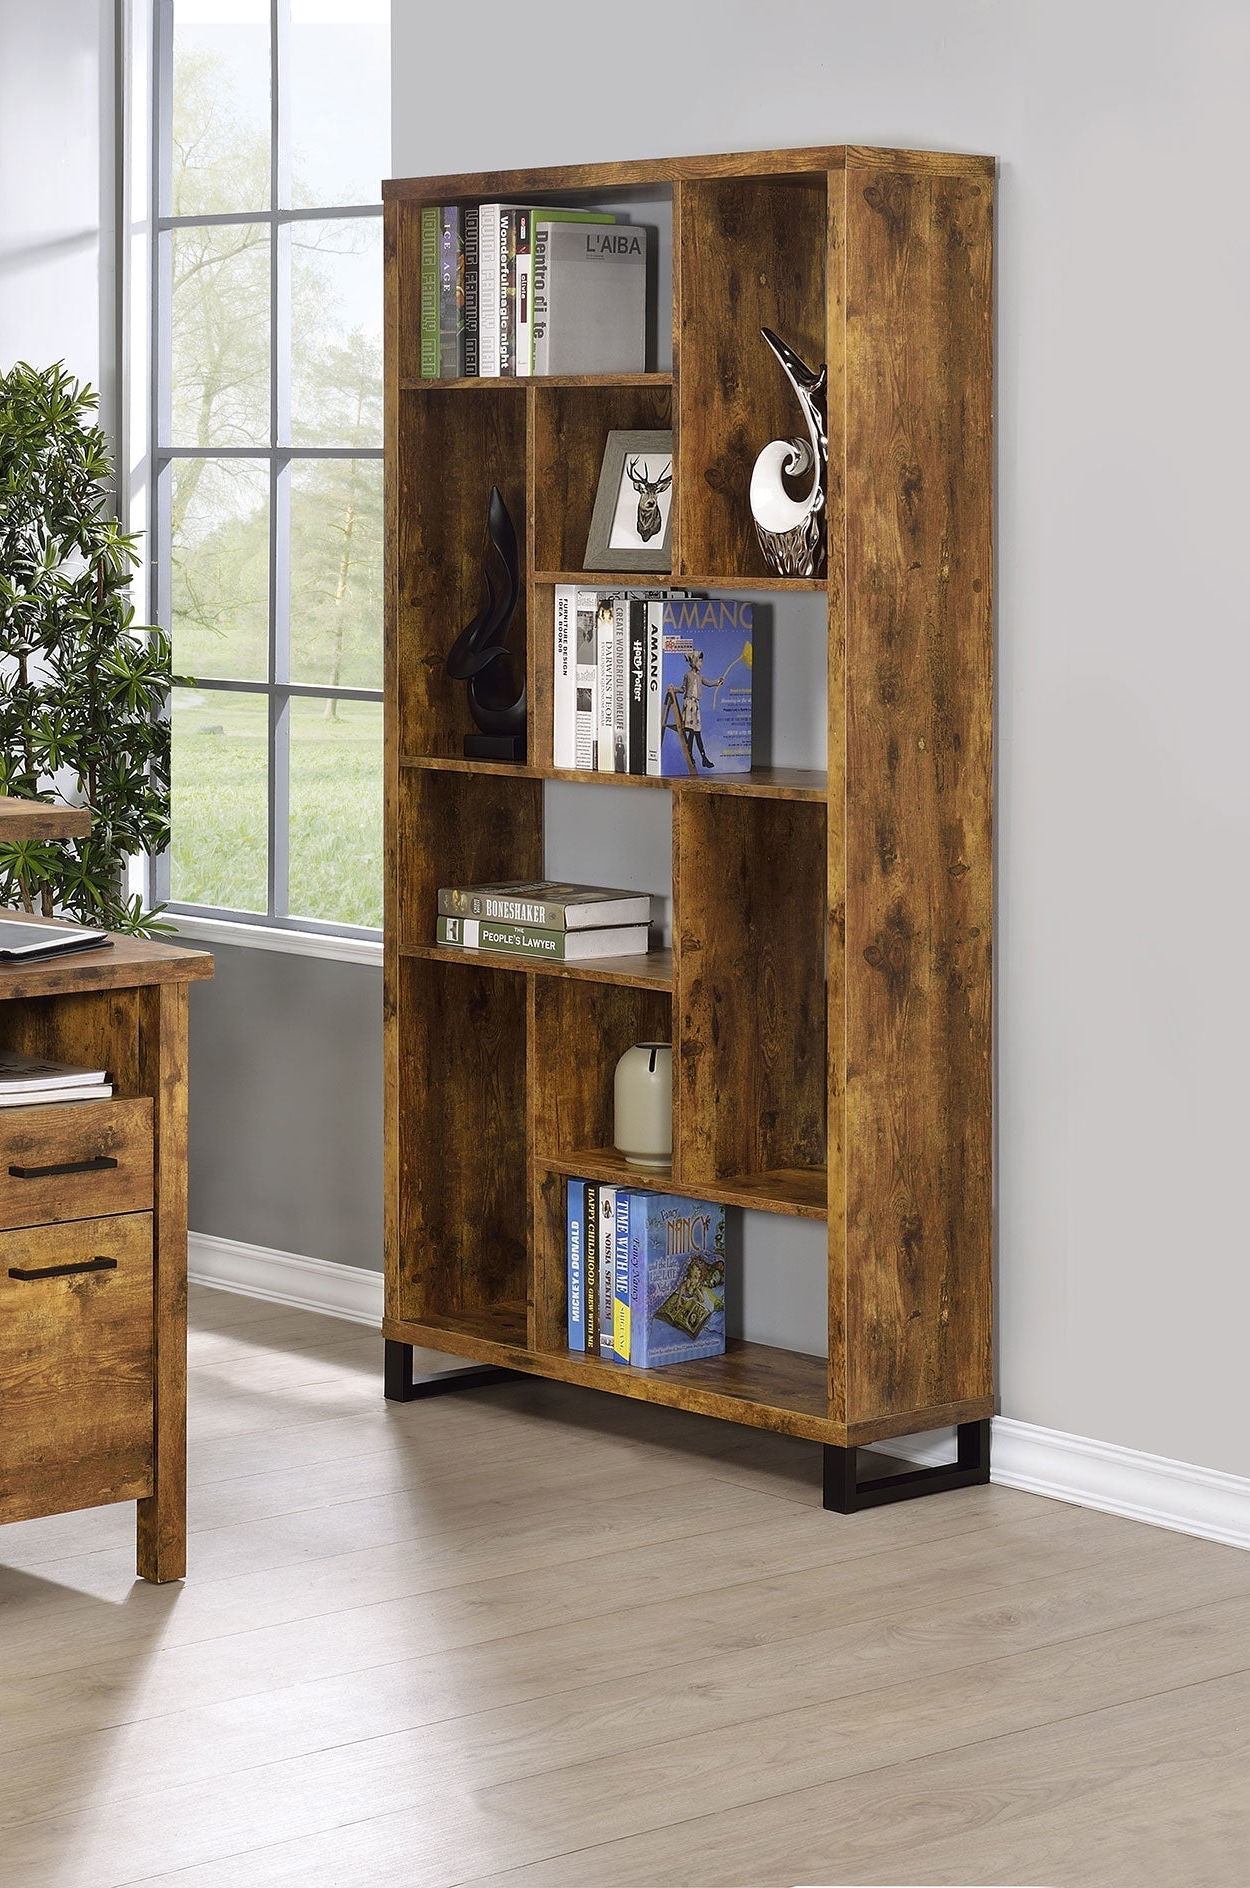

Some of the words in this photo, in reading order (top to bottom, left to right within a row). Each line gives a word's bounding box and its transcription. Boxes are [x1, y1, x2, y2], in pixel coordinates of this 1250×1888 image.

[422, 210, 436, 266] LOVING
[443, 223, 451, 249] ICE
[465, 209, 478, 265] LOVING
[481, 207, 495, 263] LOVING
[586, 234, 642, 255] L'AIBA
[443, 262, 451, 292] AGE
[534, 230, 549, 290] Dentro
[422, 271, 436, 332] FAMILY
[465, 271, 478, 332] FAMILY
[481, 268, 495, 329] FAMILY
[534, 296, 547, 313] di
[533, 322, 547, 339] te
[422, 338, 436, 375] MAN
[465, 338, 477, 376] MAN
[481, 336, 495, 373] MAN
[500, 332, 509, 369] night
[633, 639, 643, 670] Harry
[650, 624, 658, 692] AMANG
[631, 670, 643, 702] Potter
[616, 690, 624, 730] HOMELIFE
[485, 899, 546, 924] BONESHAKER
[482, 930, 521, 946] PEOPLE'S
[522, 935, 556, 951] LAWYER
[616, 1200, 629, 1234] TIME
[667, 1215, 710, 1255] NANCY
[571, 1220, 580, 1270] DONALD
[587, 1223, 595, 1285] CHILDHOOD
[616, 1236, 629, 1276] WITH
[631, 1238, 640, 1267] Fancy
[616, 1277, 628, 1294] ME
[631, 1270, 640, 1303] Nancy
[587, 1335, 594, 1348] ME
